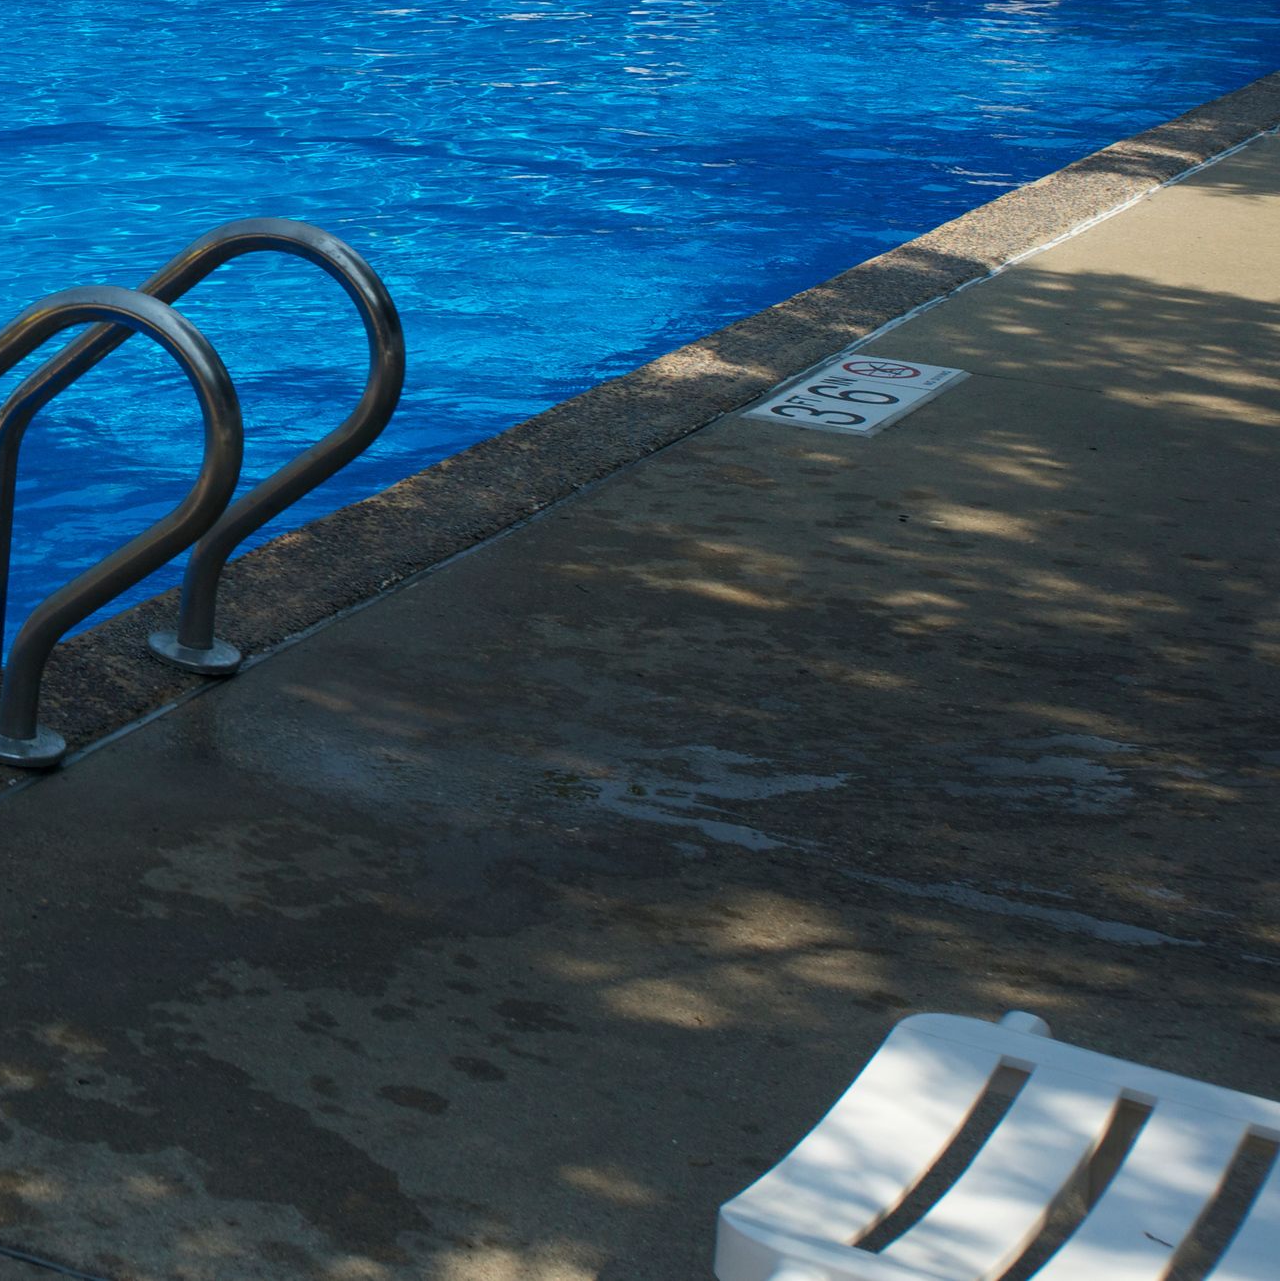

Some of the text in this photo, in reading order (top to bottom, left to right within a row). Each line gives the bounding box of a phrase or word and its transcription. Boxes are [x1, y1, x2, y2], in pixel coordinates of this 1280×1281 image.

[784, 395, 822, 406] FT
[807, 385, 900, 404] 6
[770, 405, 866, 425] 3
